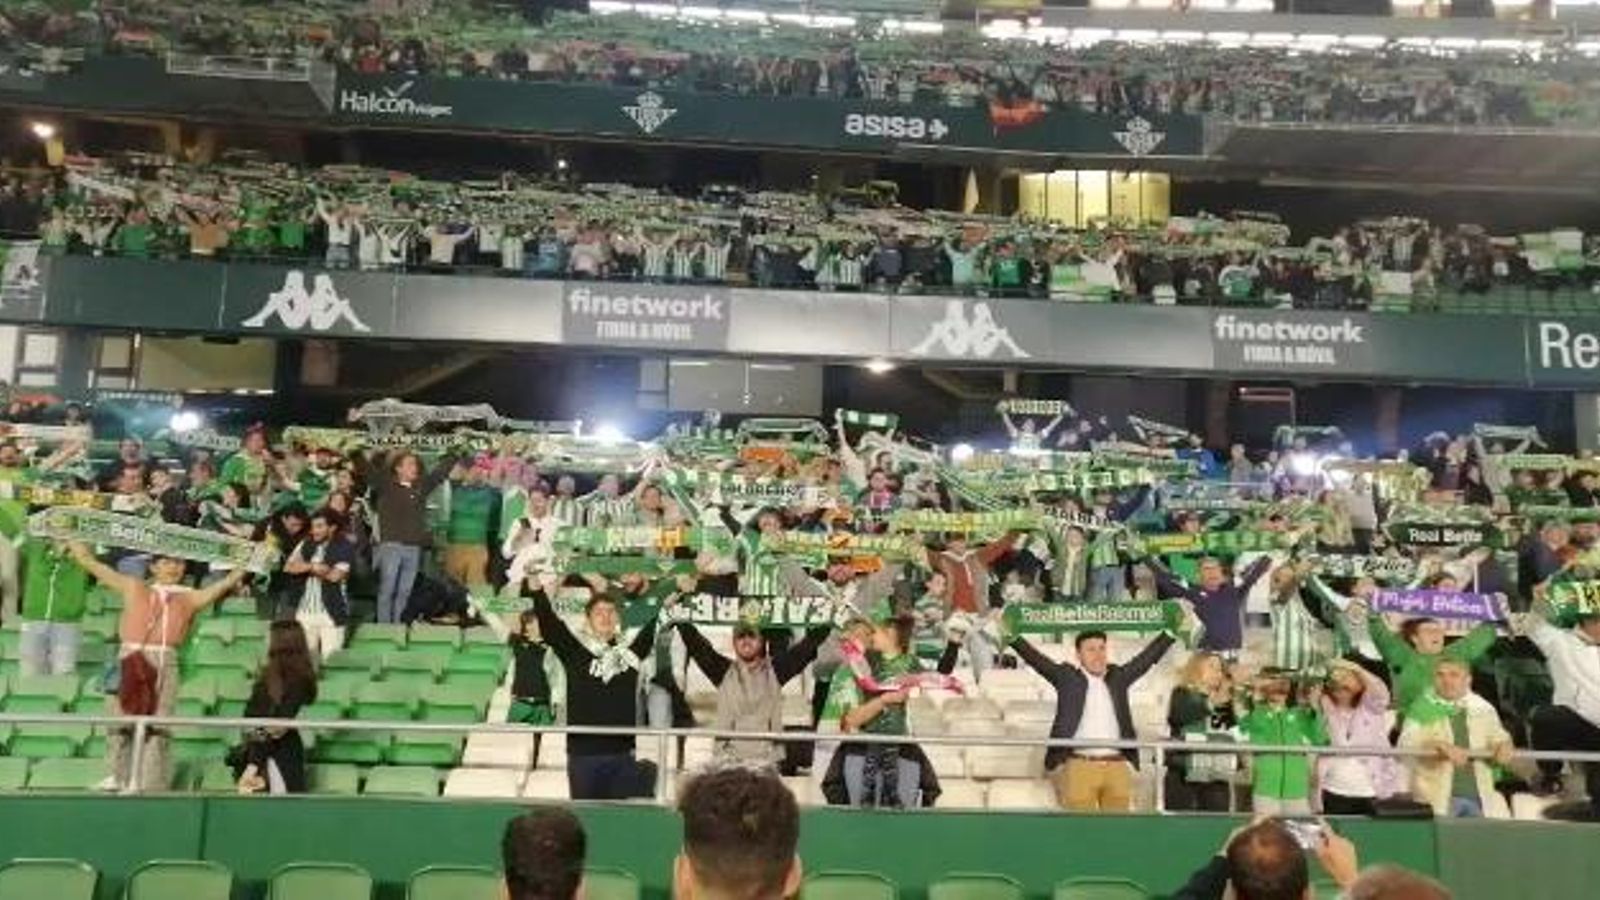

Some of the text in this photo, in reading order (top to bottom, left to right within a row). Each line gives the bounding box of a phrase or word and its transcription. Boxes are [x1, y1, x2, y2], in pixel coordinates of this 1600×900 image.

[845, 113, 926, 138] asisa
[569, 288, 722, 320] finetwork
[1215, 314, 1364, 342] finetwork
[1540, 321, 1600, 368] Re
